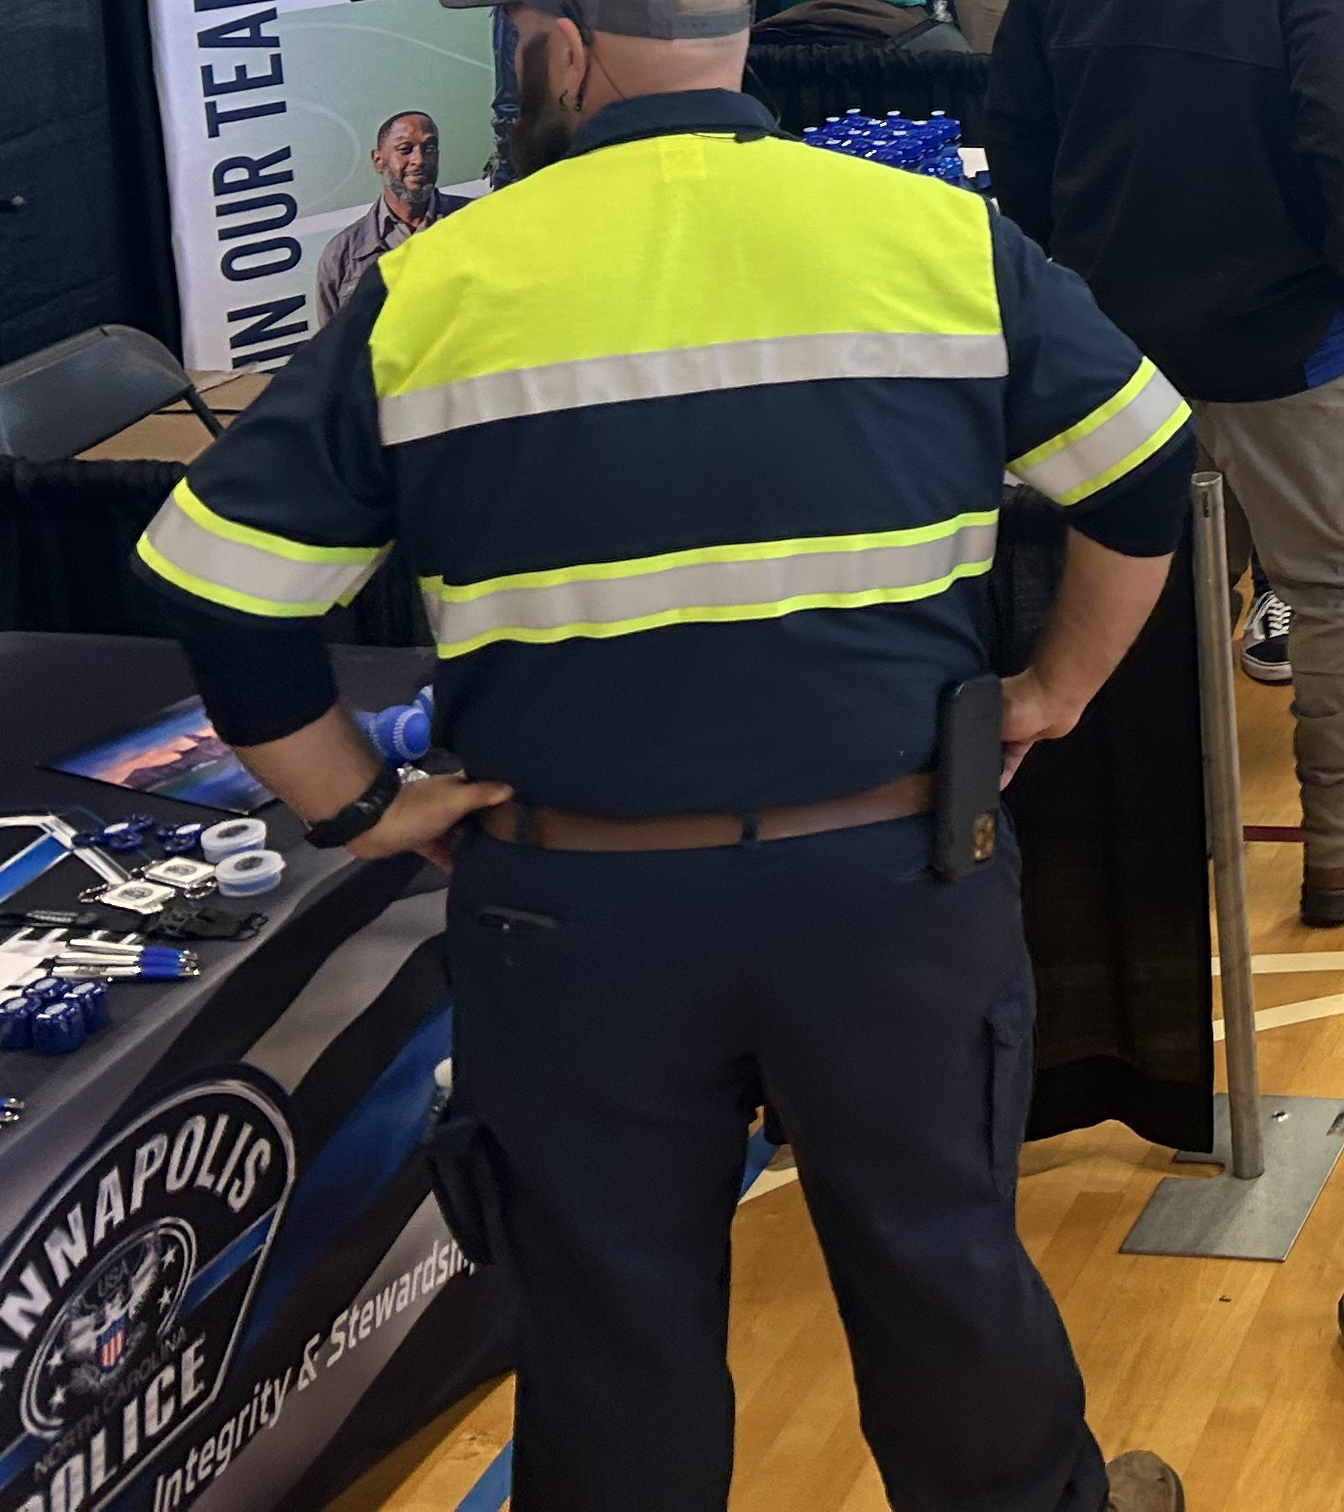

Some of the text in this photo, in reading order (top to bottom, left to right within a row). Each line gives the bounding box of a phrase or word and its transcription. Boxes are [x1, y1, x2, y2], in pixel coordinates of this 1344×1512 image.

[211, 145, 302, 282] OUR
[226, 292, 309, 373] IN
[0, 1113, 271, 1343] NNAPOLIS
[15, 1332, 207, 1512] OLICE
[153, 1366, 293, 1512] Integrity
[297, 1332, 321, 1392] &
